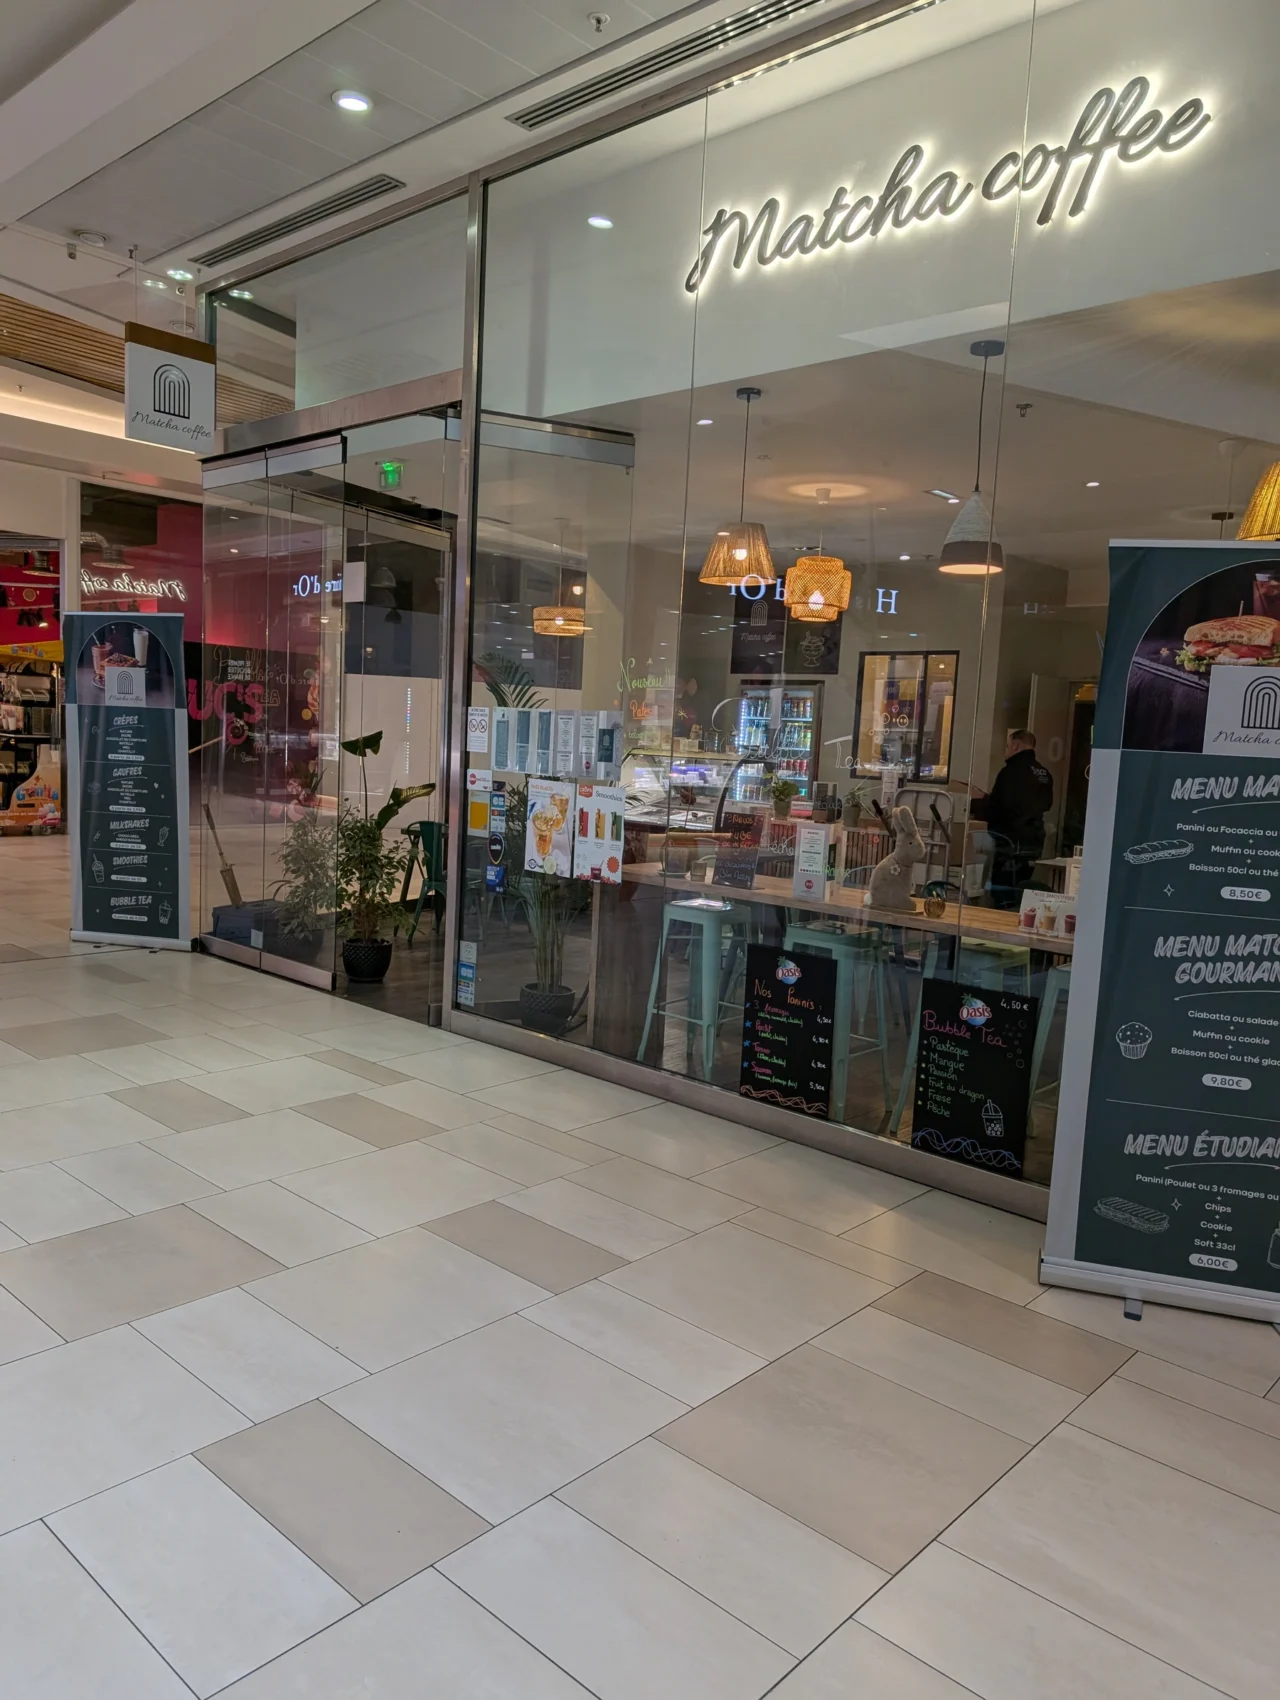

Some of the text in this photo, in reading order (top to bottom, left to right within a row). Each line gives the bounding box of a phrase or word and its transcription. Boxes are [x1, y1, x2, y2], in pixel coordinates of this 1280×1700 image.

[685, 75, 1212, 293] Matcha coffee
[131, 411, 212, 441] Matcha coffee
[187, 675, 265, 724] UC'S
[1213, 730, 1272, 745] Matcha
[1170, 776, 1239, 800] MENU
[110, 819, 150, 830] MILKSHAKES
[1176, 823, 1205, 832] Panini
[1207, 825, 1218, 833] ou
[1220, 826, 1263, 836] Focaccia
[1211, 845, 1241, 854] Muffin
[113, 855, 148, 866] SMOOTHIES
[1189, 864, 1225, 873] Boisson
[1227, 866, 1247, 874] 50cl
[1263, 869, 1279, 877] thé
[110, 896, 152, 906] BUBBLE TEA
[1154, 935, 1220, 958] MENU
[776, 966, 802, 981] Oasis
[754, 979, 772, 999] Nos
[787, 987, 815, 1010] Paninis
[959, 1006, 992, 1021] Oasis
[1188, 1010, 1231, 1022] Ciabatta
[1246, 1018, 1279, 1027] salade
[922, 1010, 1008, 1048] Bubble Tea
[1192, 1030, 1270, 1045] Muffin ou cookie
[930, 1036, 970, 1060] Pastèque
[1171, 1047, 1207, 1058] Boisson
[1208, 1051, 1228, 1060] 50cl
[1230, 1054, 1242, 1062] ou
[1243, 1056, 1260, 1064] thé
[930, 1052, 965, 1075] Mangue
[928, 1064, 958, 1081] Passion
[928, 1077, 985, 1103] Fruit du dragon
[928, 1089, 952, 1104] Fraise
[927, 1101, 950, 1118] Pêche
[1124, 1134, 1189, 1157] MENU
[1136, 1174, 1164, 1185] Panini
[1164, 1178, 1197, 1190] (Poulet
[1212, 1184, 1218, 1192] 3
[1219, 1186, 1265, 1199] fromages
[1205, 1203, 1232, 1213] Chips
[1200, 1221, 1233, 1232] Cookie
[1194, 1239, 1236, 1251] Soft 33cl
